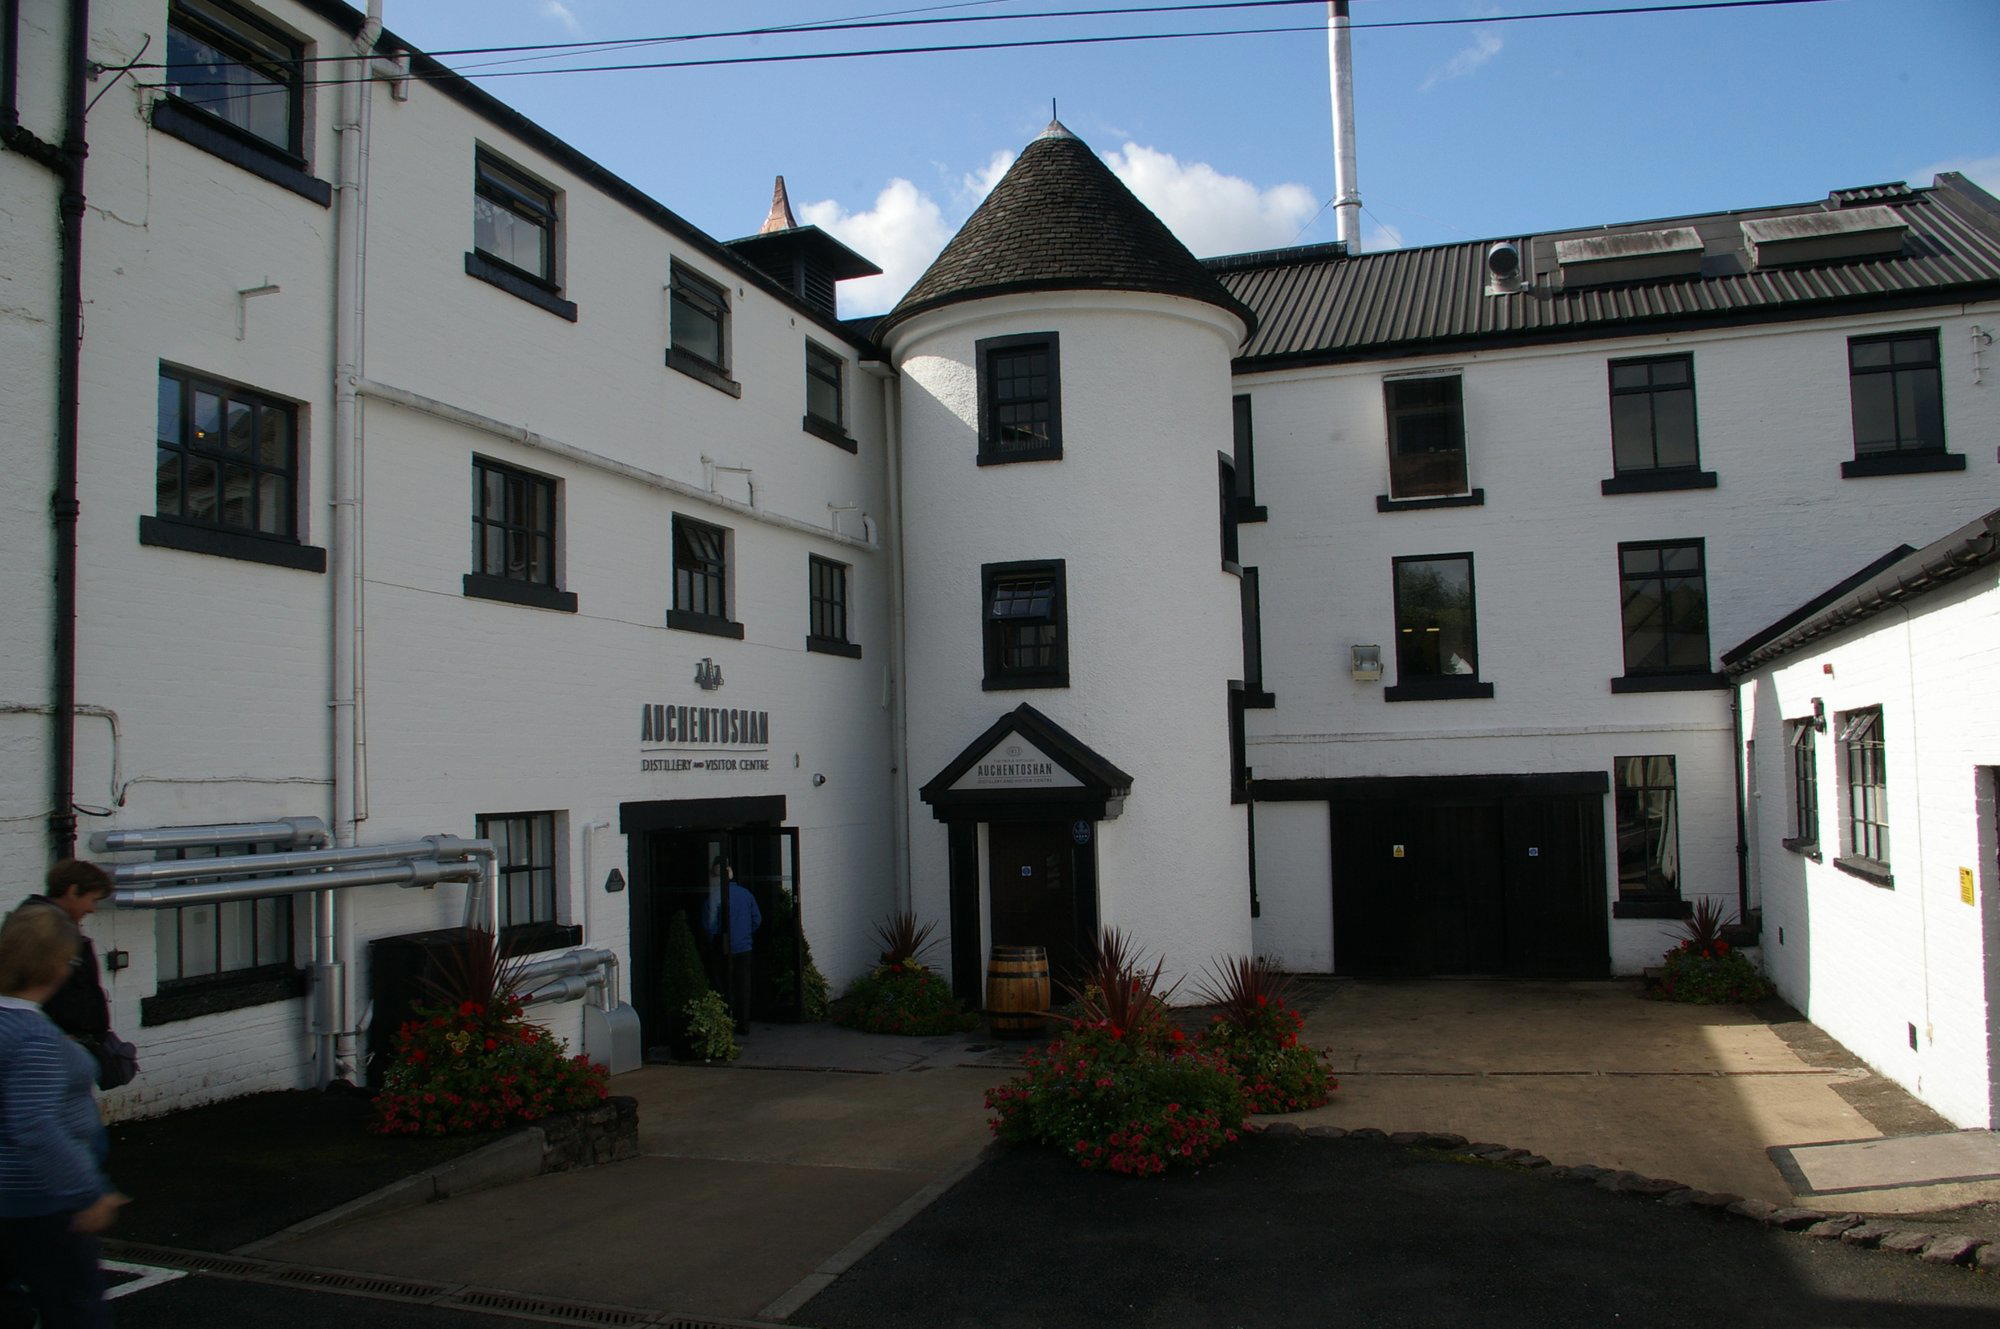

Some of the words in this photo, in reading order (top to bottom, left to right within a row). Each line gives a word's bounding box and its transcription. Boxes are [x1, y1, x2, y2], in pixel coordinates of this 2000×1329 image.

[641, 703, 769, 744] AUCHENTOSHAN
[641, 759, 692, 771] DISTILLERY
[705, 759, 737, 771] VISITOR
[740, 759, 769, 771] CENTRE
[977, 763, 1052, 776] AUCHENTOSHAN
